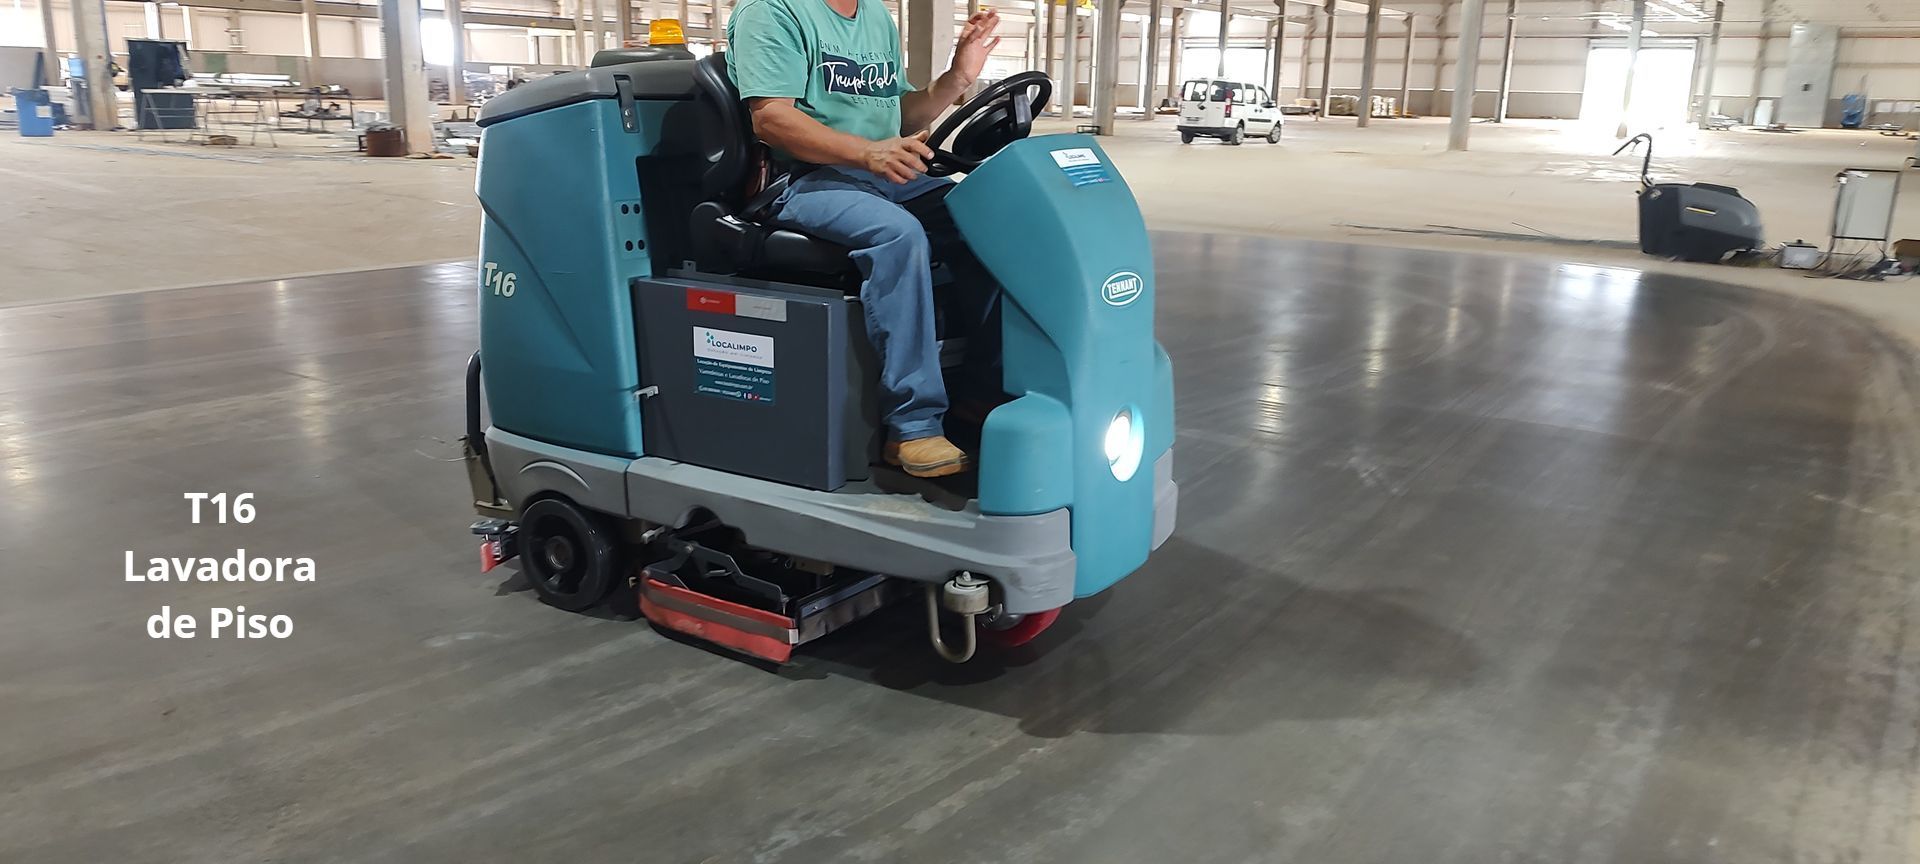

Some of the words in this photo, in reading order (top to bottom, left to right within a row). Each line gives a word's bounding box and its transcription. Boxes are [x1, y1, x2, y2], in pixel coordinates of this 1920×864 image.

[484, 261, 517, 298] T16
[1107, 277, 1138, 299] TENNANT
[711, 340, 758, 353] LOCALIMPO
